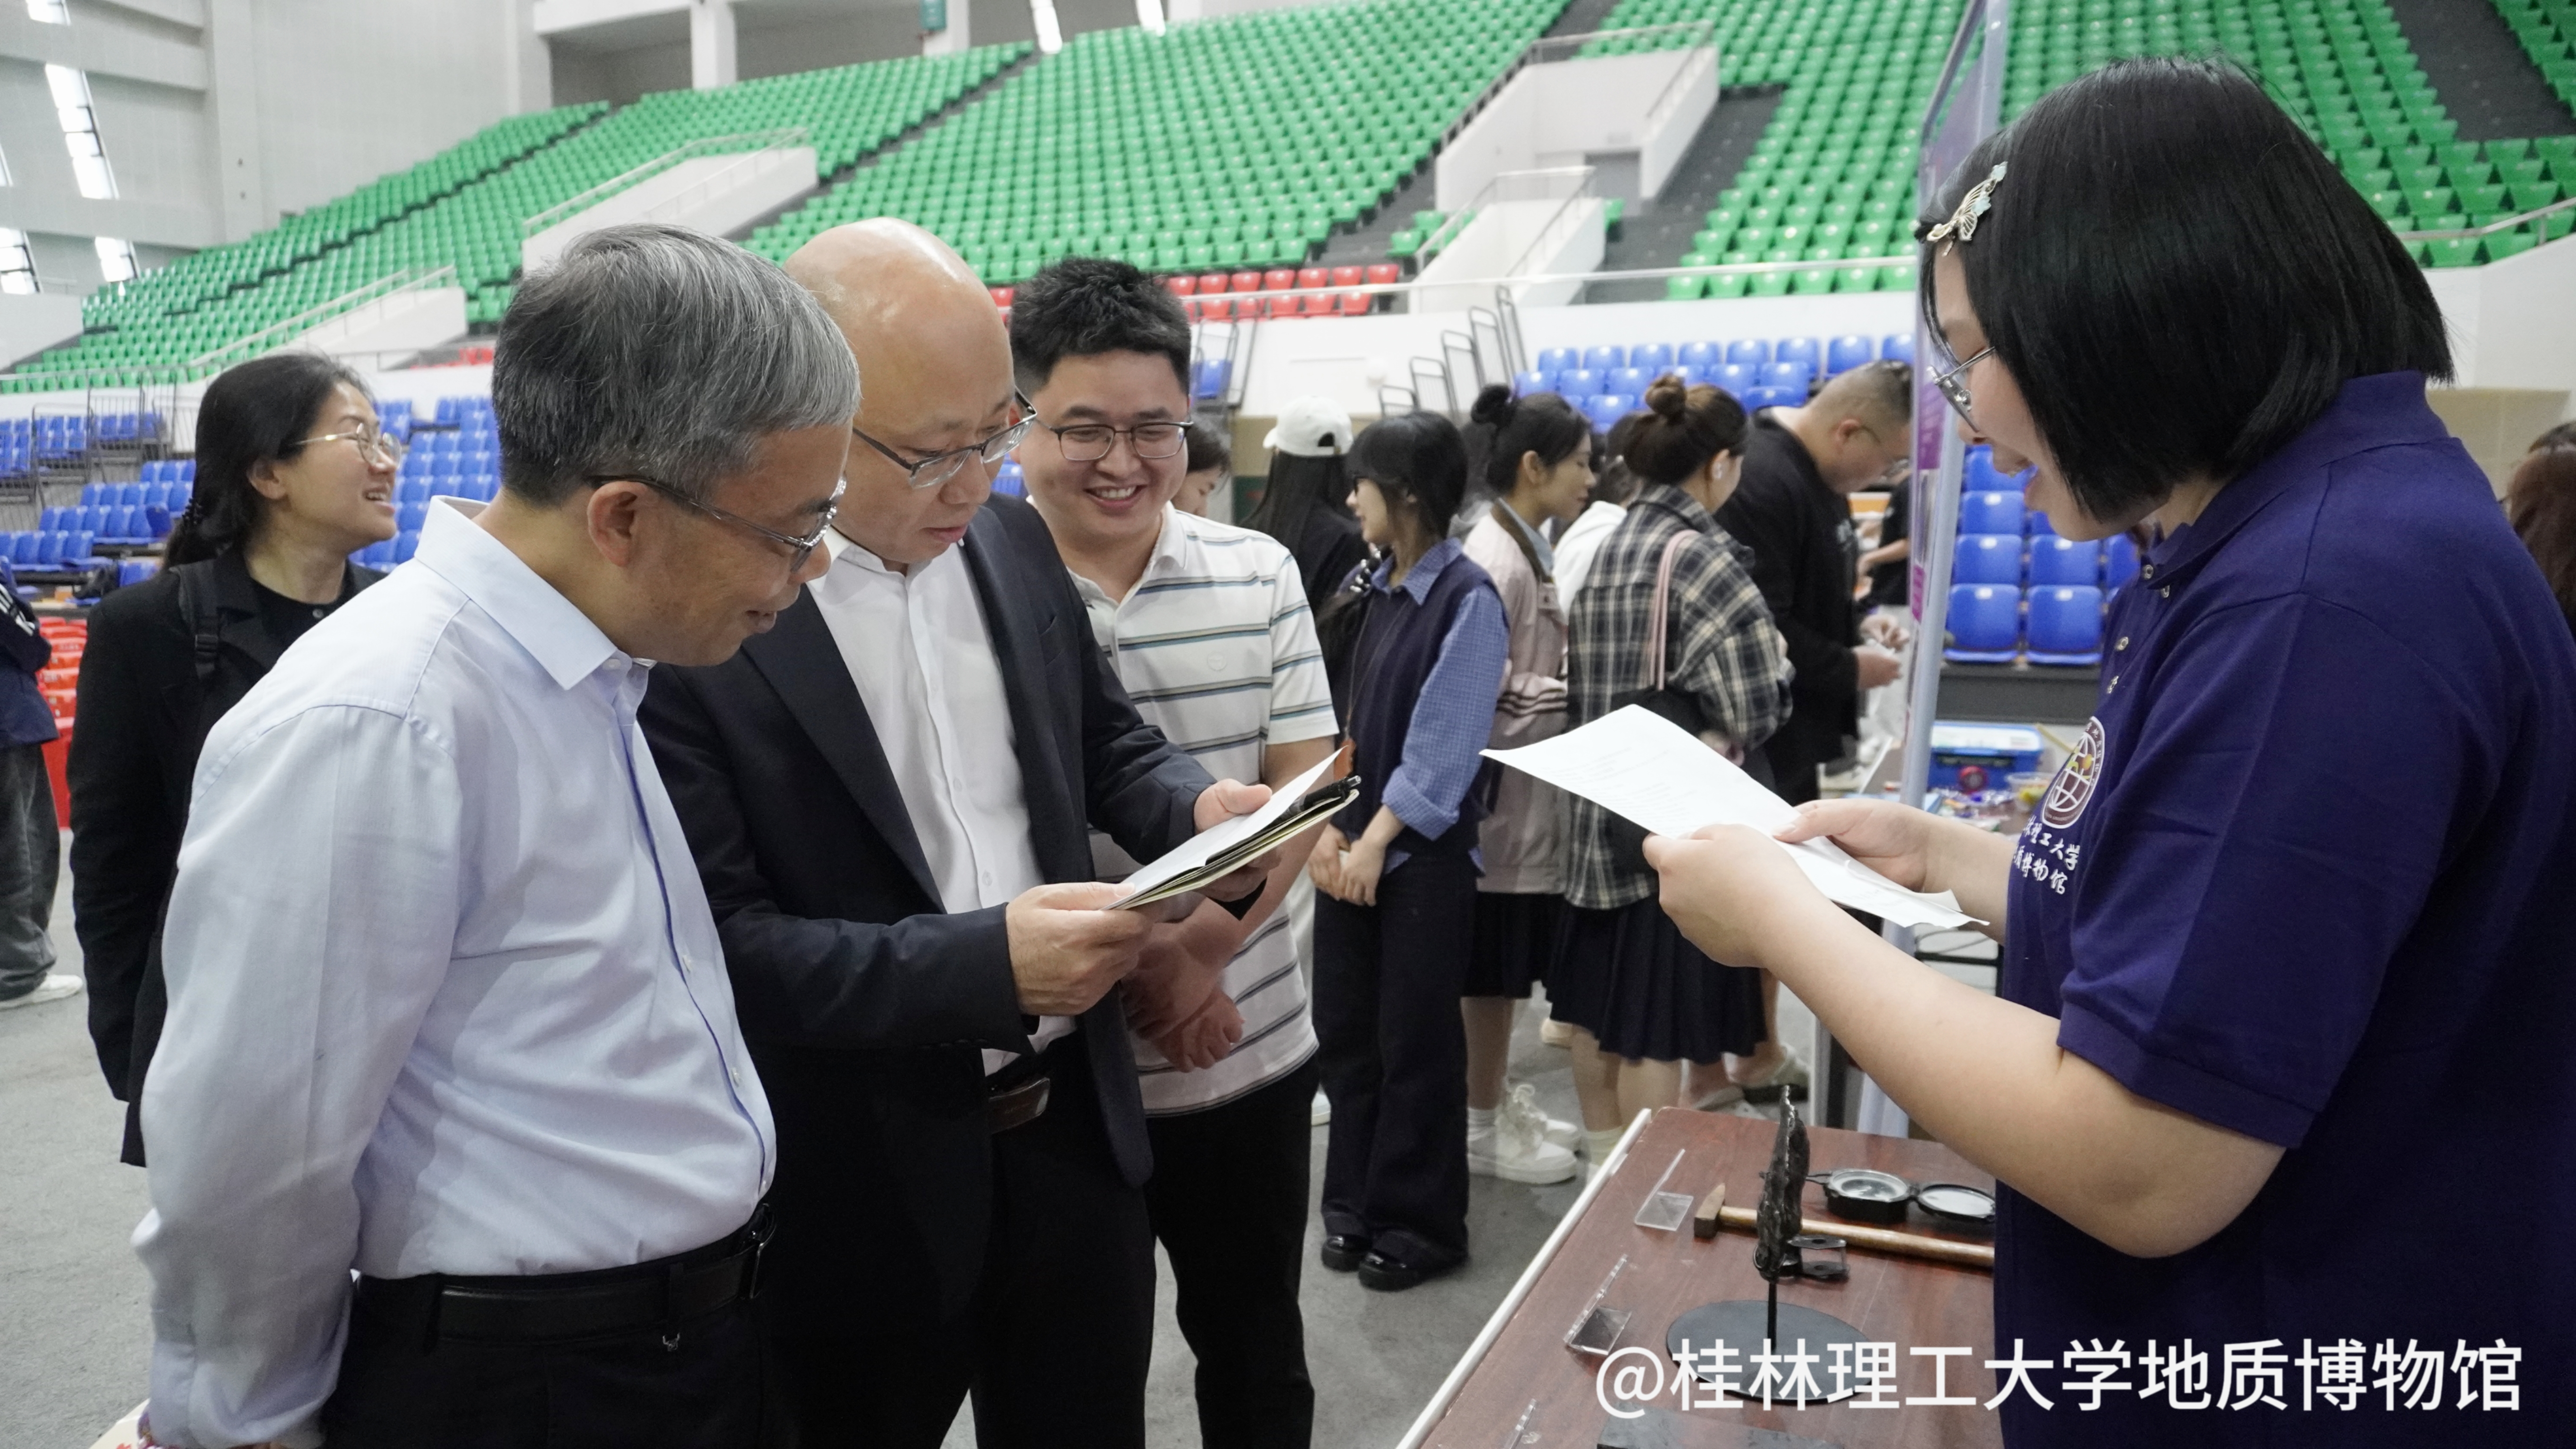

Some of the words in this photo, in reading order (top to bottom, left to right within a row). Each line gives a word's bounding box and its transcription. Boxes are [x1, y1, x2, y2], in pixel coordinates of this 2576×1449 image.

[2024, 815, 2081, 871] 林理工大学
